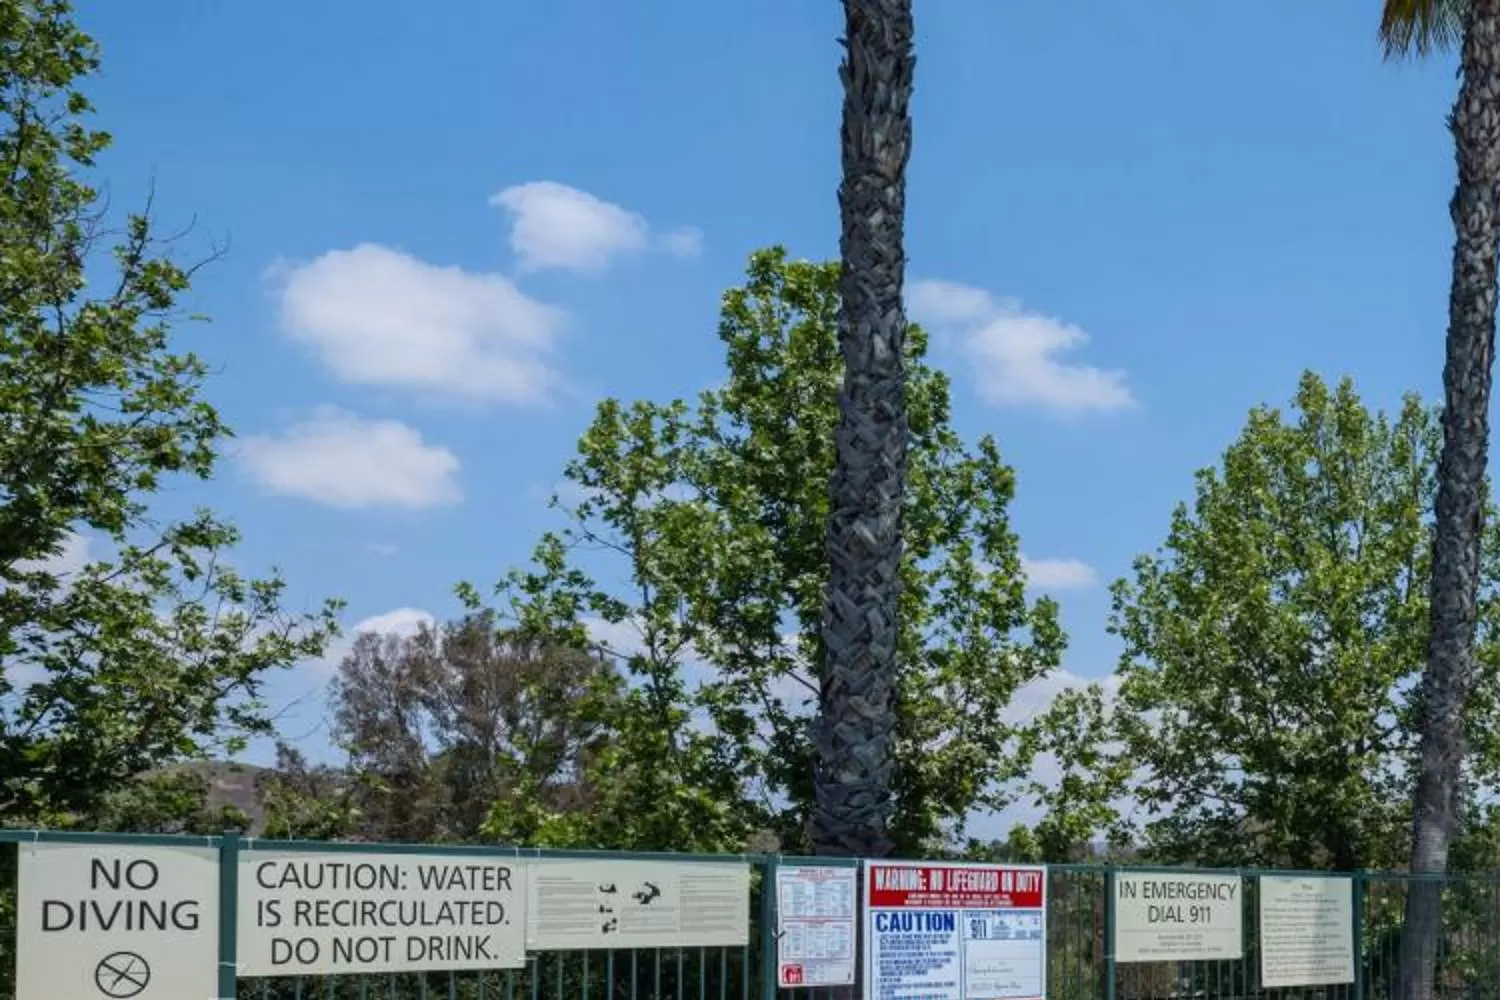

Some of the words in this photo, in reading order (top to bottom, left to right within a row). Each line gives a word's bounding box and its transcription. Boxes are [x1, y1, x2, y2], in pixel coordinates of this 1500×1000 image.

[91, 859, 159, 890] NO
[256, 862, 407, 890] CAUTION:
[418, 865, 512, 891] WATER
[1015, 871, 1040, 892] DUTY
[1119, 881, 1137, 899] IN
[1143, 881, 1237, 901] EMERGENCY
[41, 900, 200, 932] DIVING
[257, 900, 282, 928] IS
[294, 900, 511, 927] RECIRCULATED.
[876, 912, 955, 933] CAUTION
[1148, 905, 1186, 924] DIAL
[1189, 905, 1212, 924] 911
[271, 938, 320, 965] DO
[333, 937, 396, 963] NOT
[407, 935, 499, 961] DRINK.
